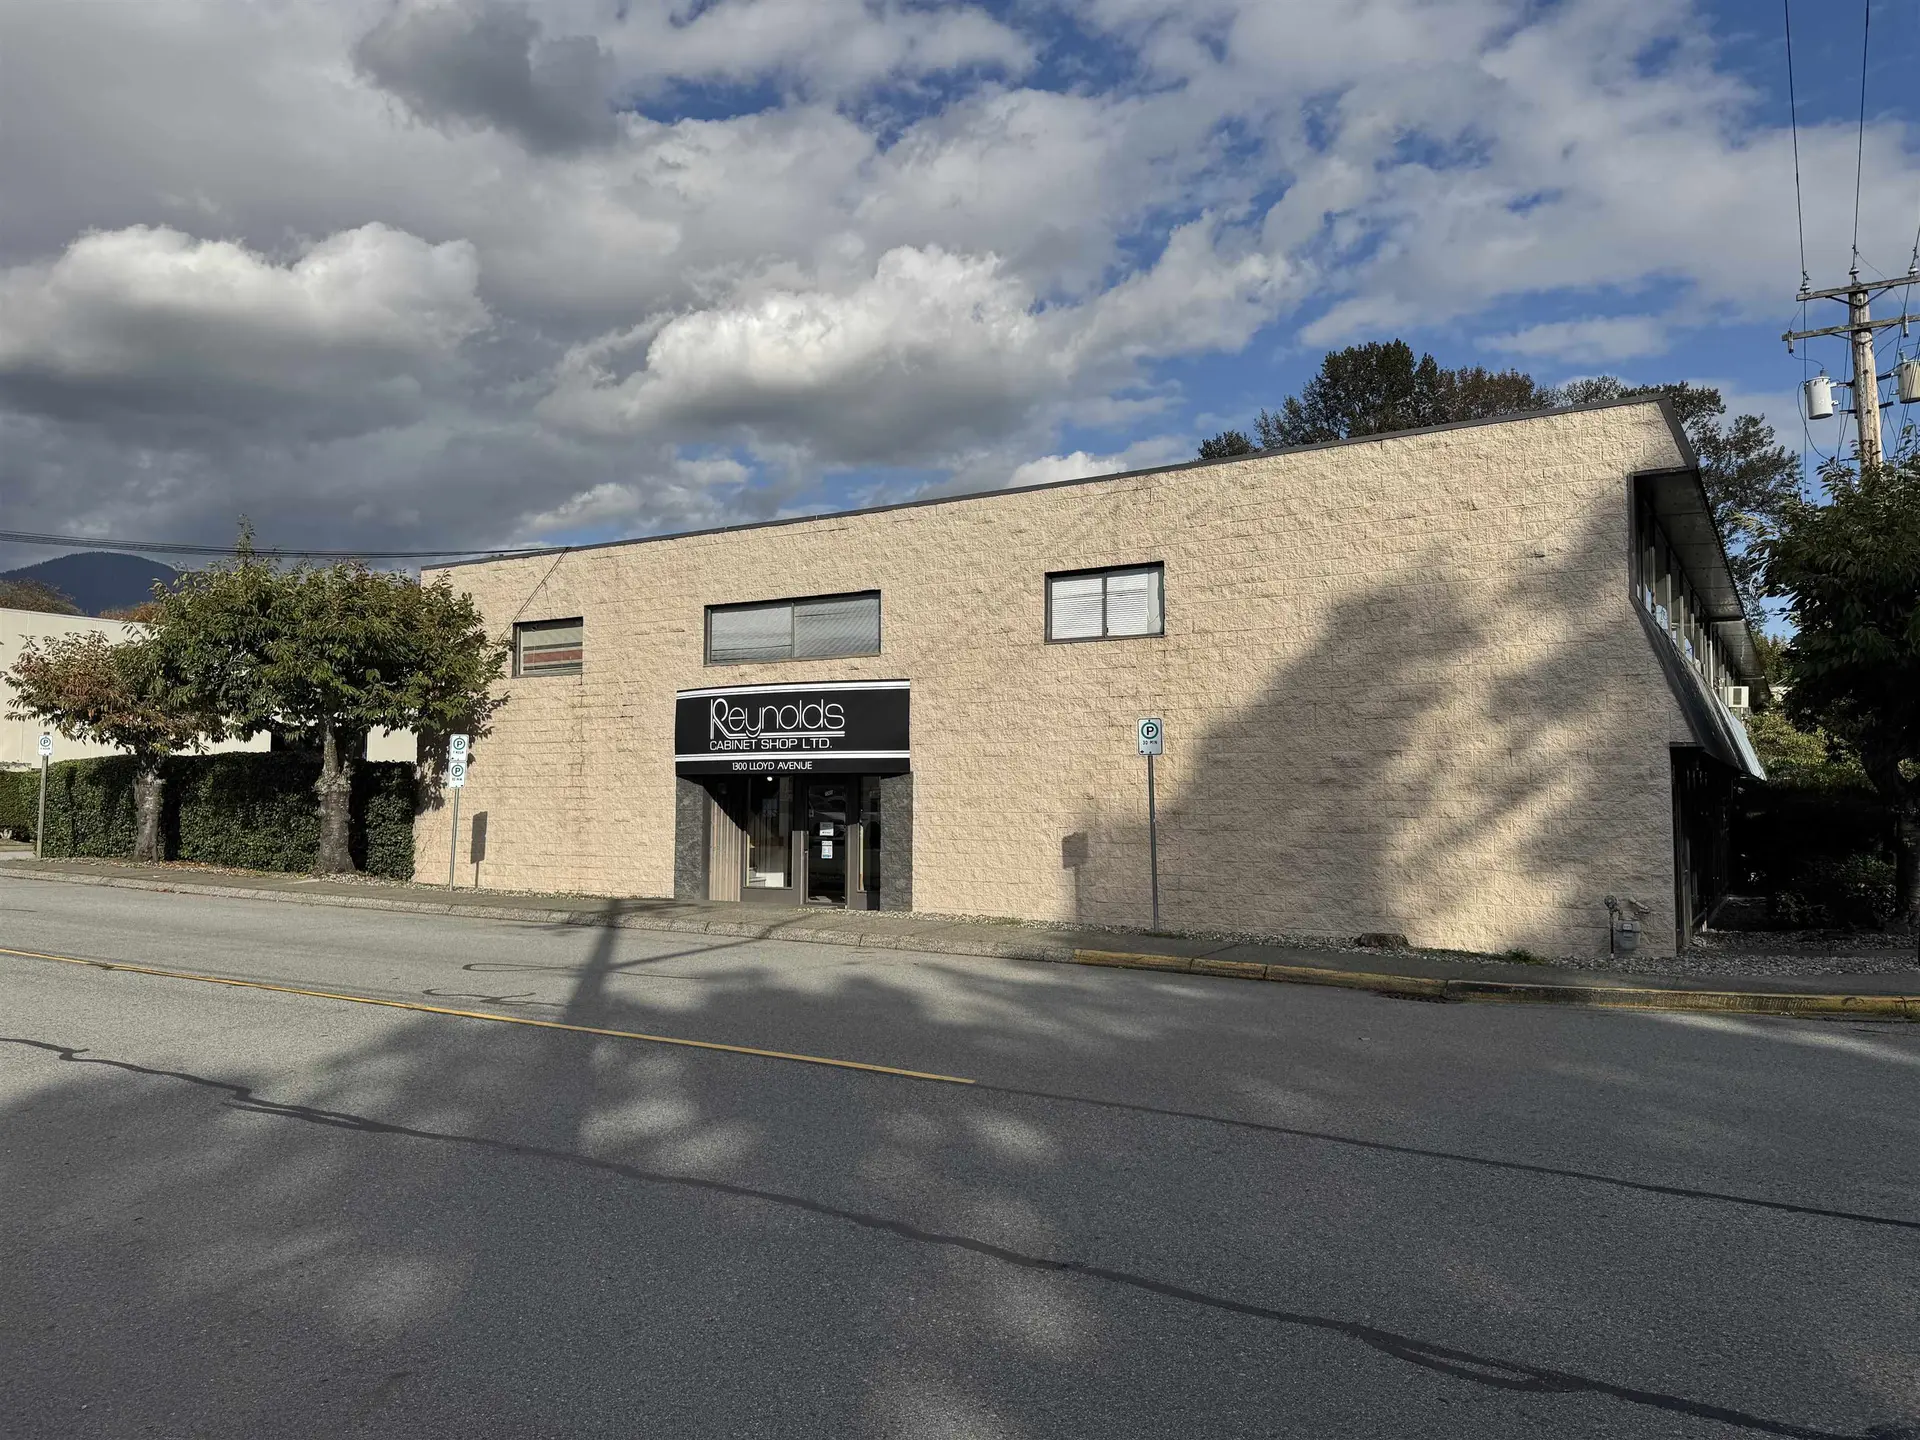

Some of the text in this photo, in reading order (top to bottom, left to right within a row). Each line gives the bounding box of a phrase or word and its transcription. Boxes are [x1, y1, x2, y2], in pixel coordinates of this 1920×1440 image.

[710, 698, 845, 739] Reynolds
[1146, 726, 1154, 735] P
[709, 738, 833, 751] CABINET SHOP LTD.
[732, 761, 813, 771] 1300 LLOYD AVENUE
